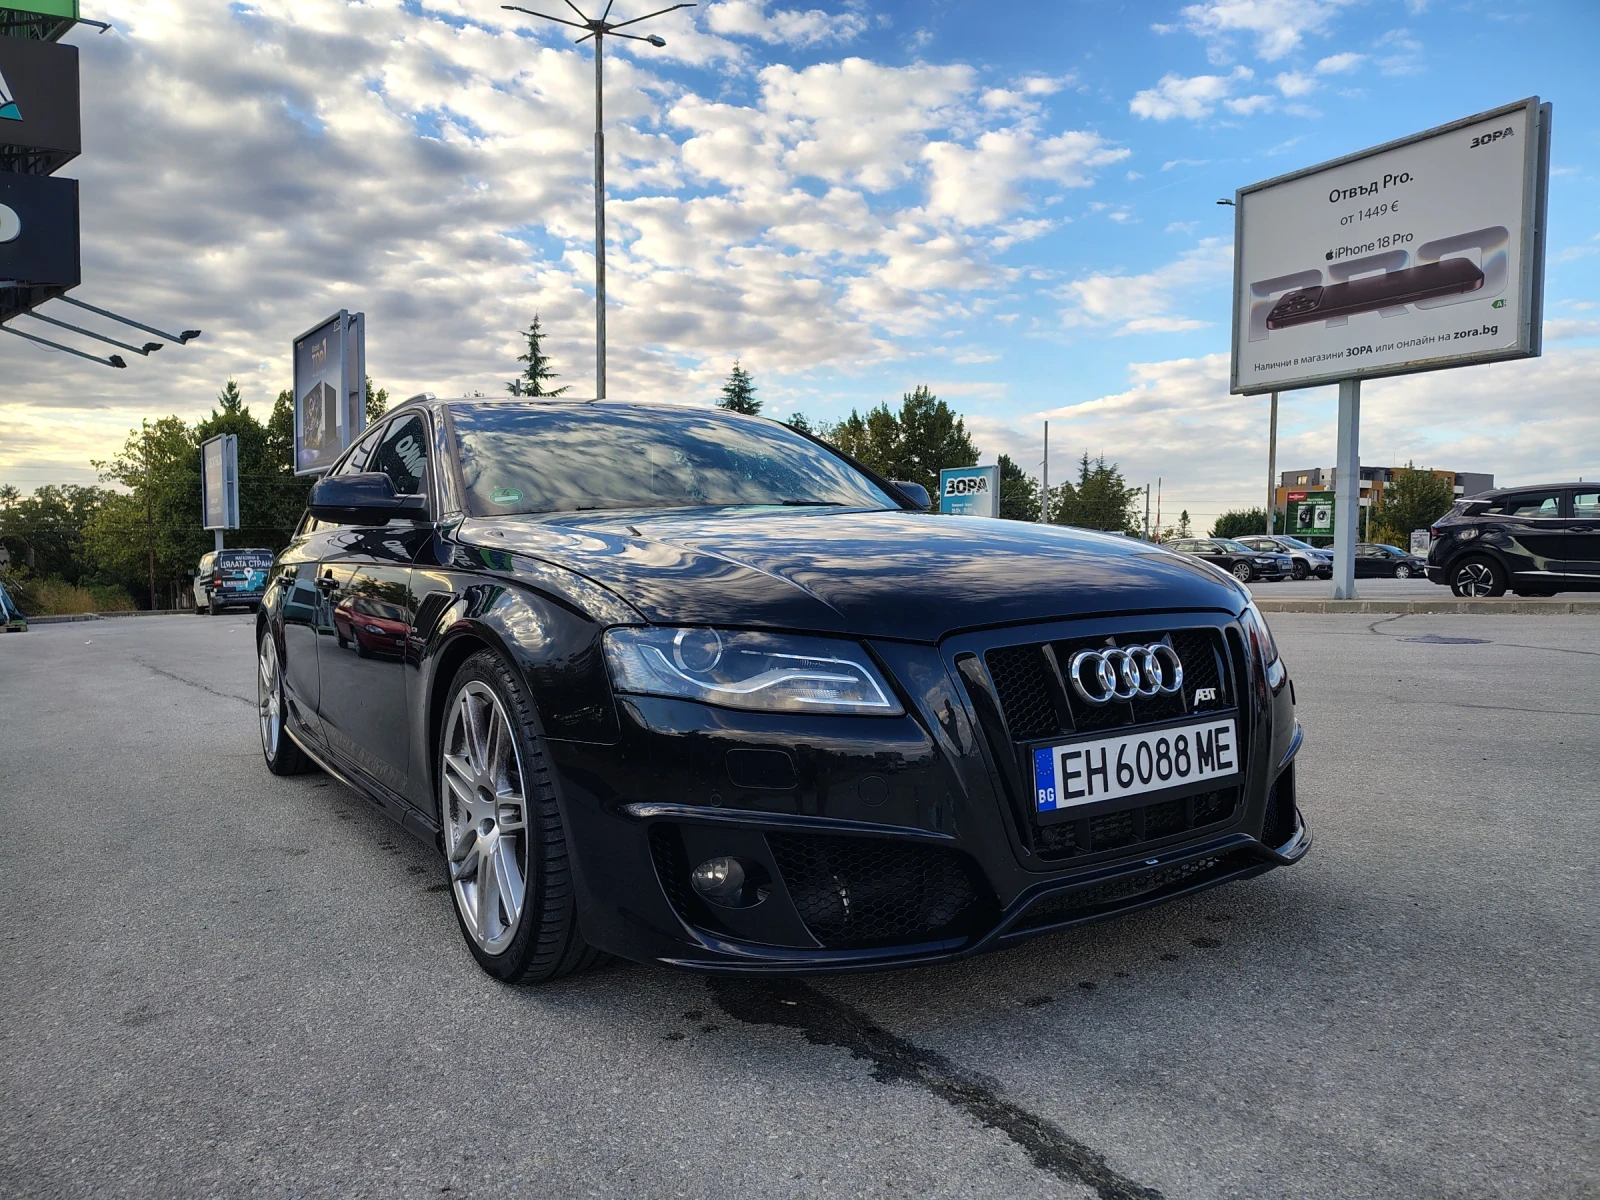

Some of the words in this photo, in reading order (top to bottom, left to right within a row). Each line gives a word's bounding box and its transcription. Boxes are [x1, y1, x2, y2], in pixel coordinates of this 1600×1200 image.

[1469, 126, 1515, 149] ЗОРА
[1328, 181, 1379, 203] Отвъд
[1383, 172, 1414, 189] Pro.
[1340, 214, 1355, 226] от
[1358, 203, 1388, 221] 1449
[1390, 200, 1399, 212] €
[1334, 241, 1375, 259] iPhone
[1377, 236, 1391, 250] 18
[1392, 232, 1414, 246] Pro
[1254, 359, 1292, 371] Налични
[1300, 351, 1344, 364] магазини
[1345, 345, 1373, 357] ЗОРА
[1375, 343, 1394, 352] или
[1396, 335, 1435, 349] онлайн
[1438, 333, 1451, 342] на
[1453, 325, 1499, 339] zora.bg
[945, 477, 988, 496] ЗОРА
[220, 560, 247, 569] ЦЯЛАТА
[1193, 687, 1217, 706] ABT
[1060, 746, 1109, 800] EH
[1116, 733, 1192, 789] 6088
[1195, 725, 1233, 775] ME
[1038, 788, 1055, 804] BG
